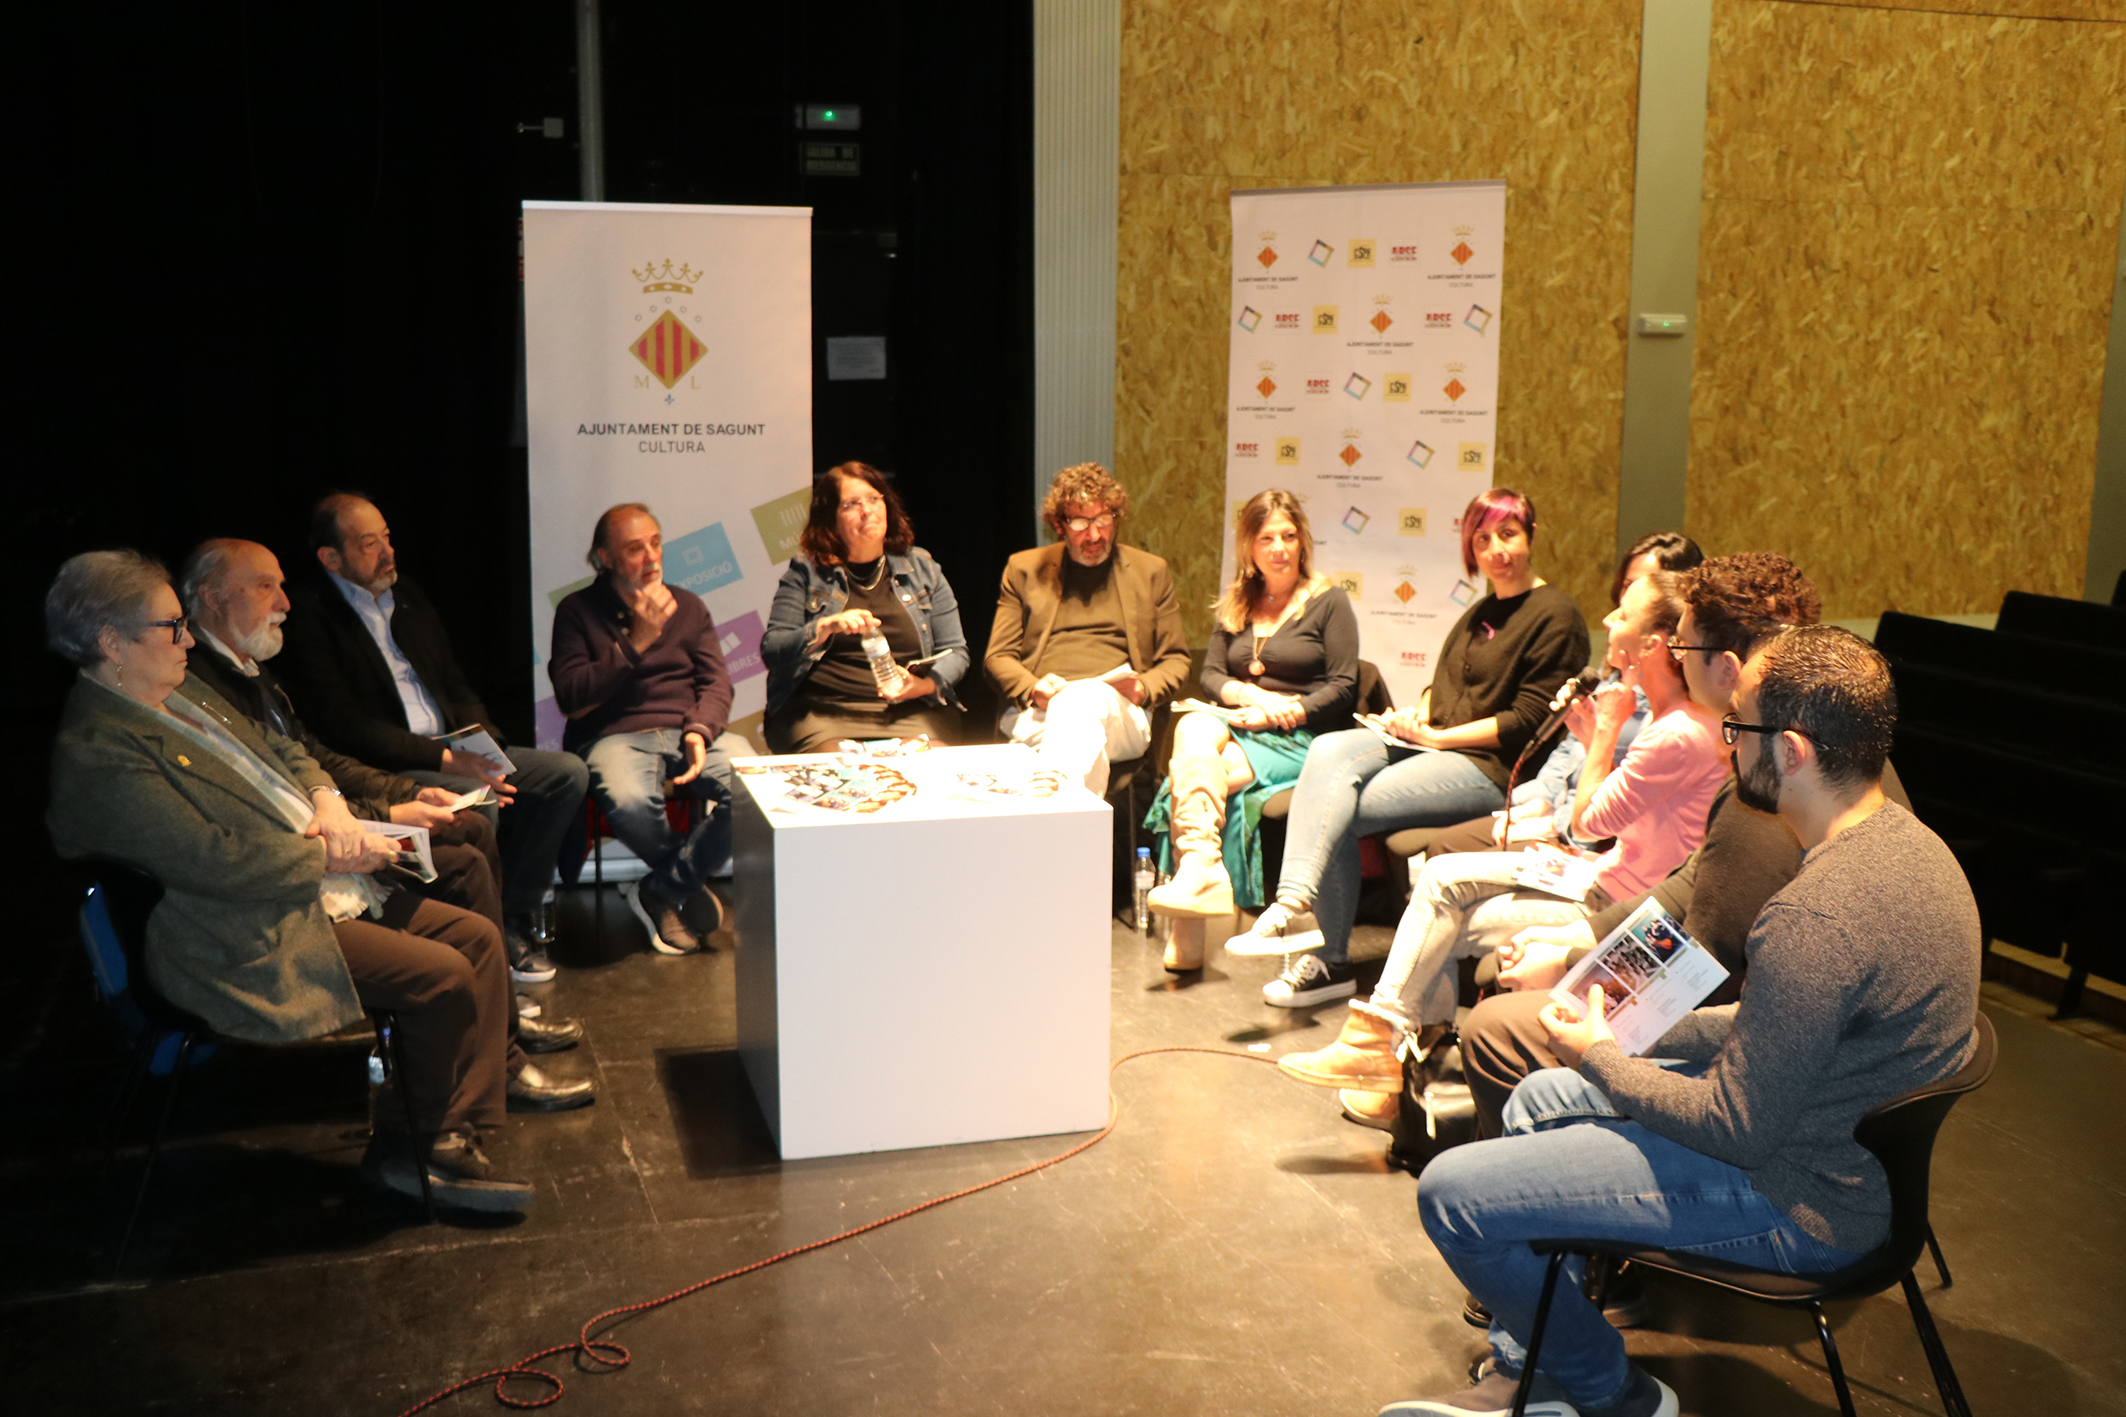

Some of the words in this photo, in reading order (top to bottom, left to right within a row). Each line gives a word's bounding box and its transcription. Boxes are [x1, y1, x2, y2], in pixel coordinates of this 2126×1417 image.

[577, 423, 680, 436] AJUNTAMENT
[683, 423, 702, 436] DE
[706, 423, 766, 436] SAGUNT
[638, 440, 706, 454] CULTURA
[672, 560, 733, 590] XPOSICIÓ
[726, 653, 761, 675] IBRES
